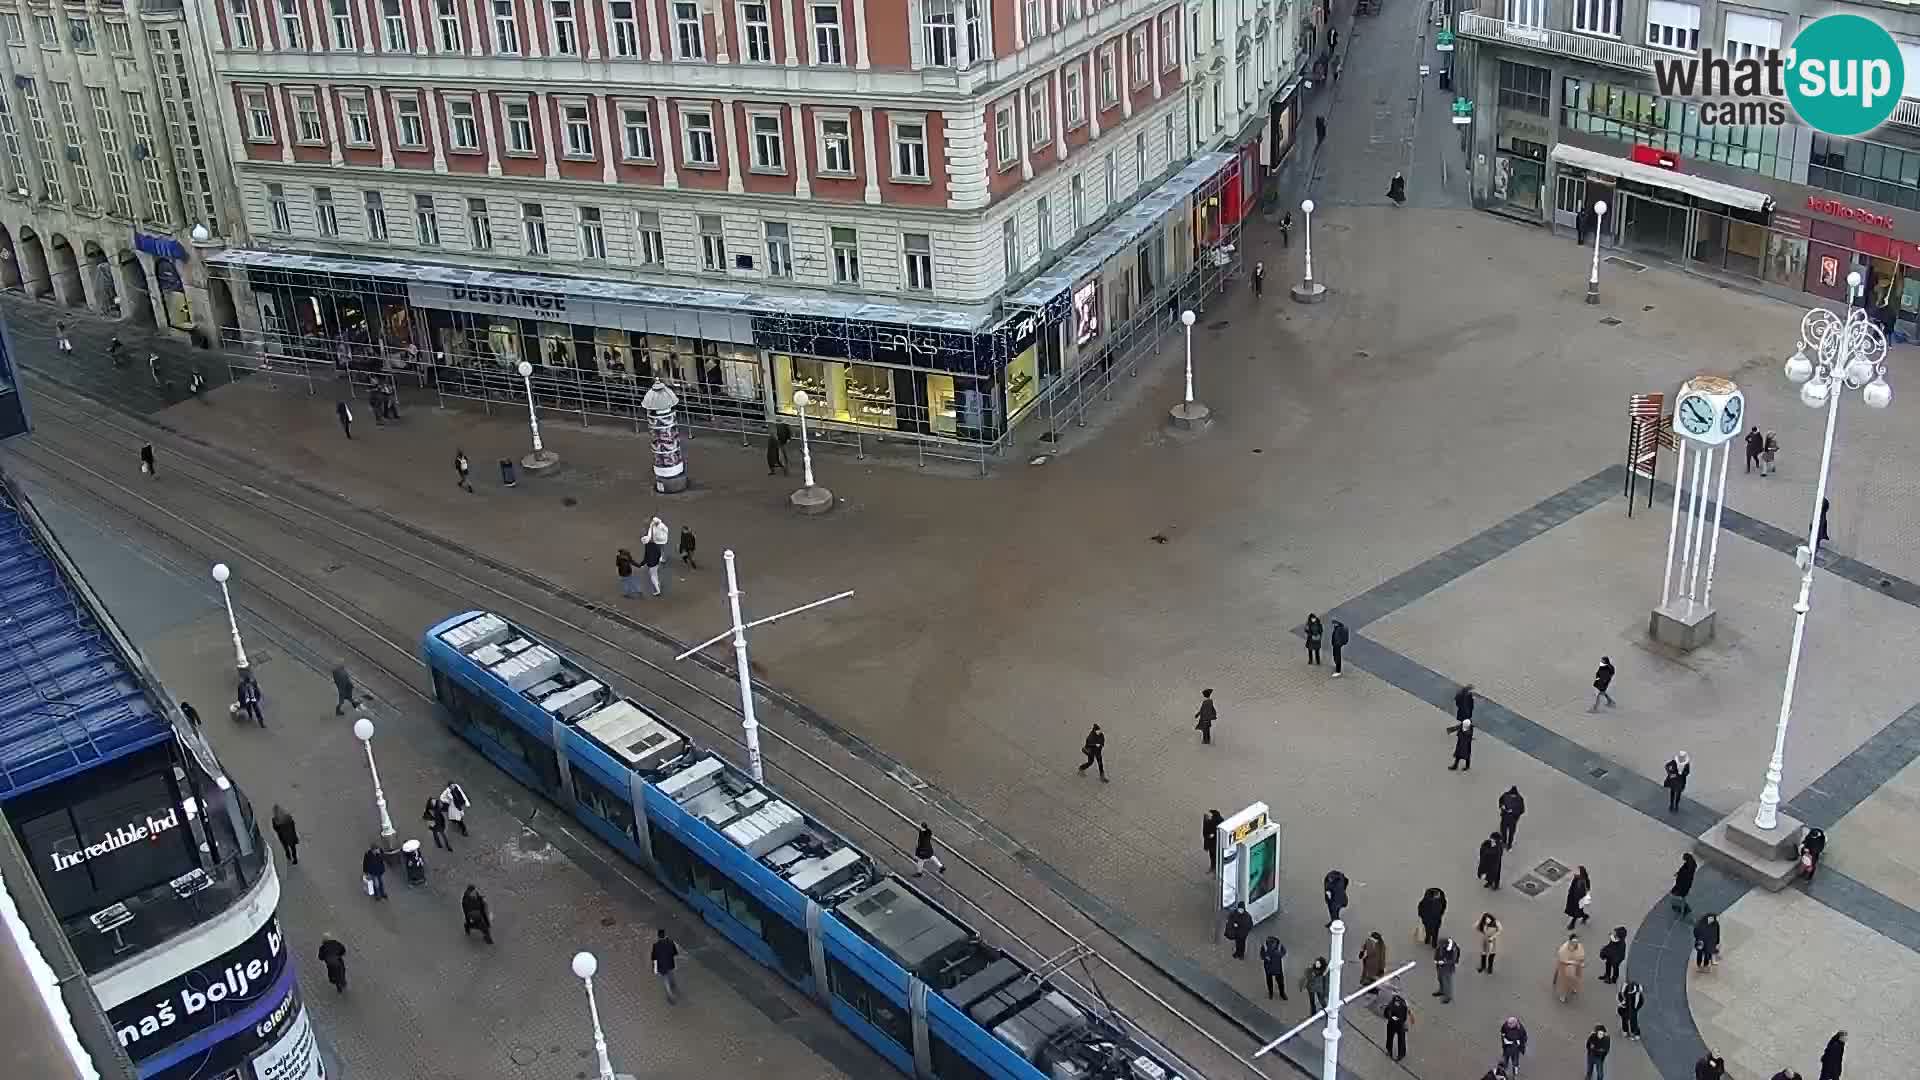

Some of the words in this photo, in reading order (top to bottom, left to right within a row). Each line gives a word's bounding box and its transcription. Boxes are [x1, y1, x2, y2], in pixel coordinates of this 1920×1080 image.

[453, 285, 566, 312] DESSANGE
[117, 999, 176, 1047] naš
[181, 958, 269, 1015] bolje,
